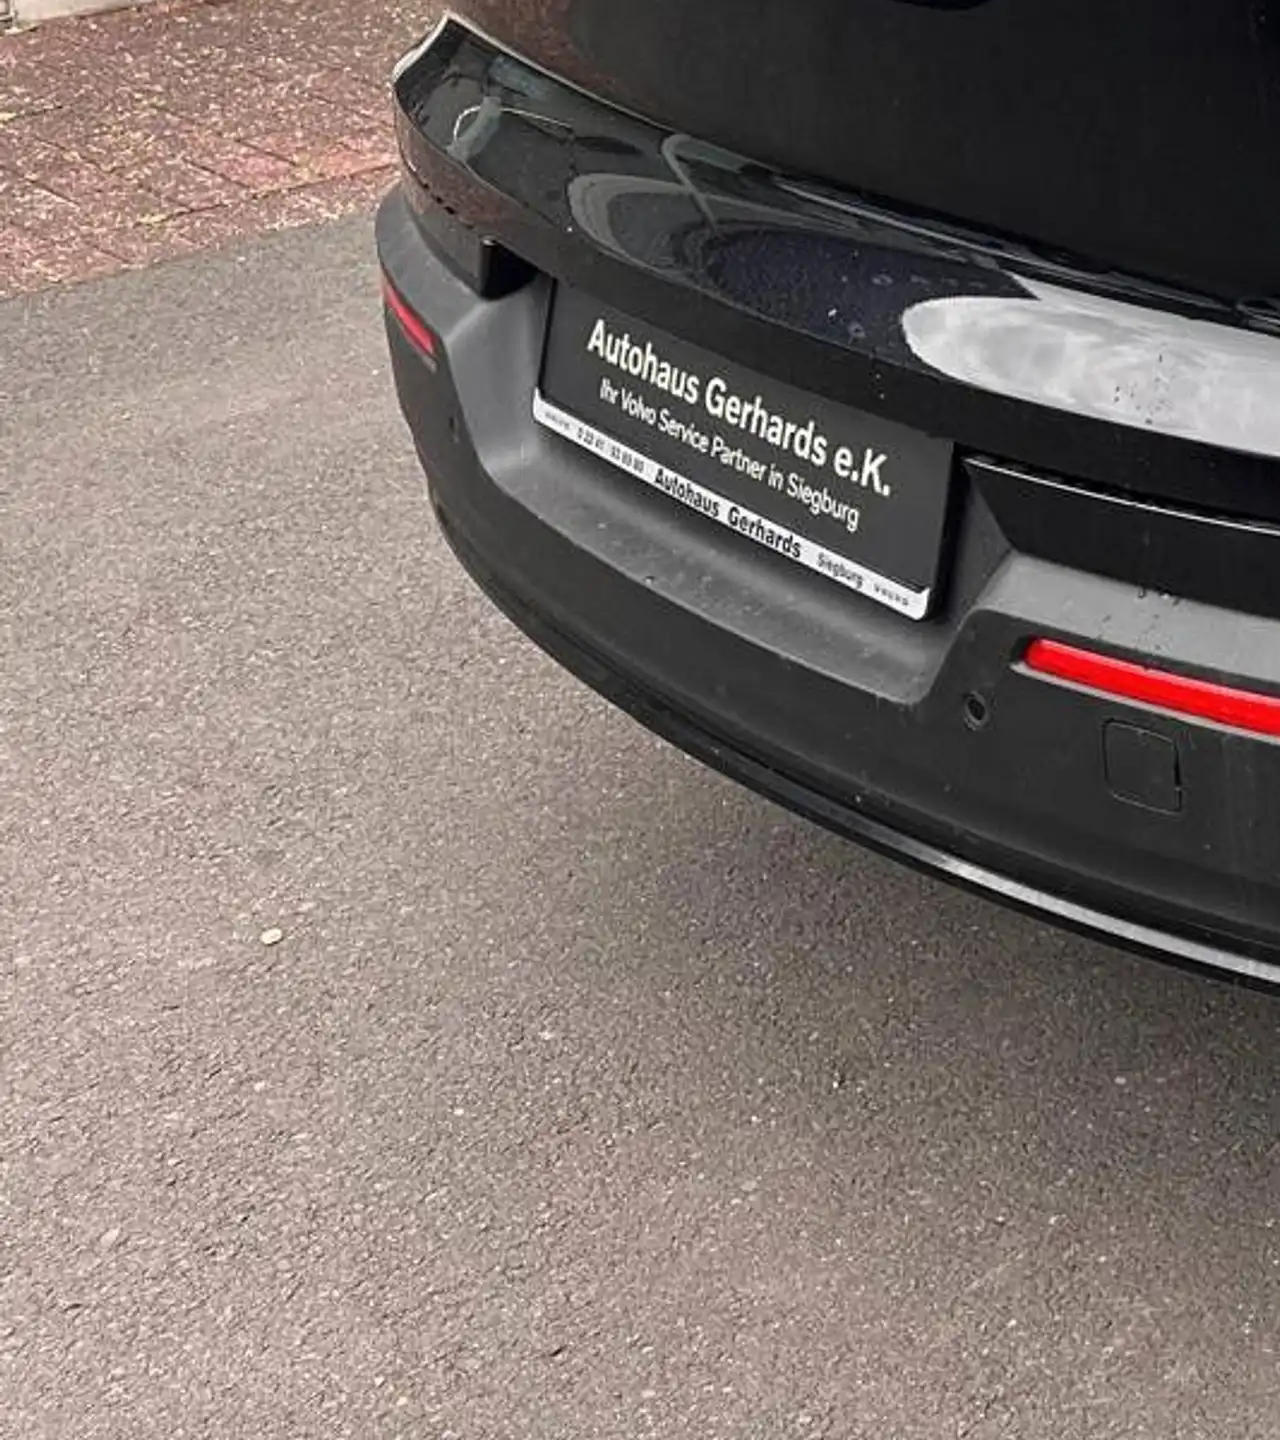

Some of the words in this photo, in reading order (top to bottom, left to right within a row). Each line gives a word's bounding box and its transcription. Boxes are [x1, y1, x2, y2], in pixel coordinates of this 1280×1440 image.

[587, 319, 699, 404] Autohaus
[705, 377, 827, 465] Gerhards
[834, 446, 891, 496] e.K.
[600, 377, 620, 404] Ihr
[621, 387, 656, 425] Volvo
[657, 408, 709, 453] Service
[710, 436, 767, 481] Partner
[768, 463, 784, 492] in
[787, 472, 859, 532] Siegburg
[655, 468, 720, 517] Autohaus
[727, 506, 801, 558] Gerhards
[817, 552, 864, 589] Siegburg
